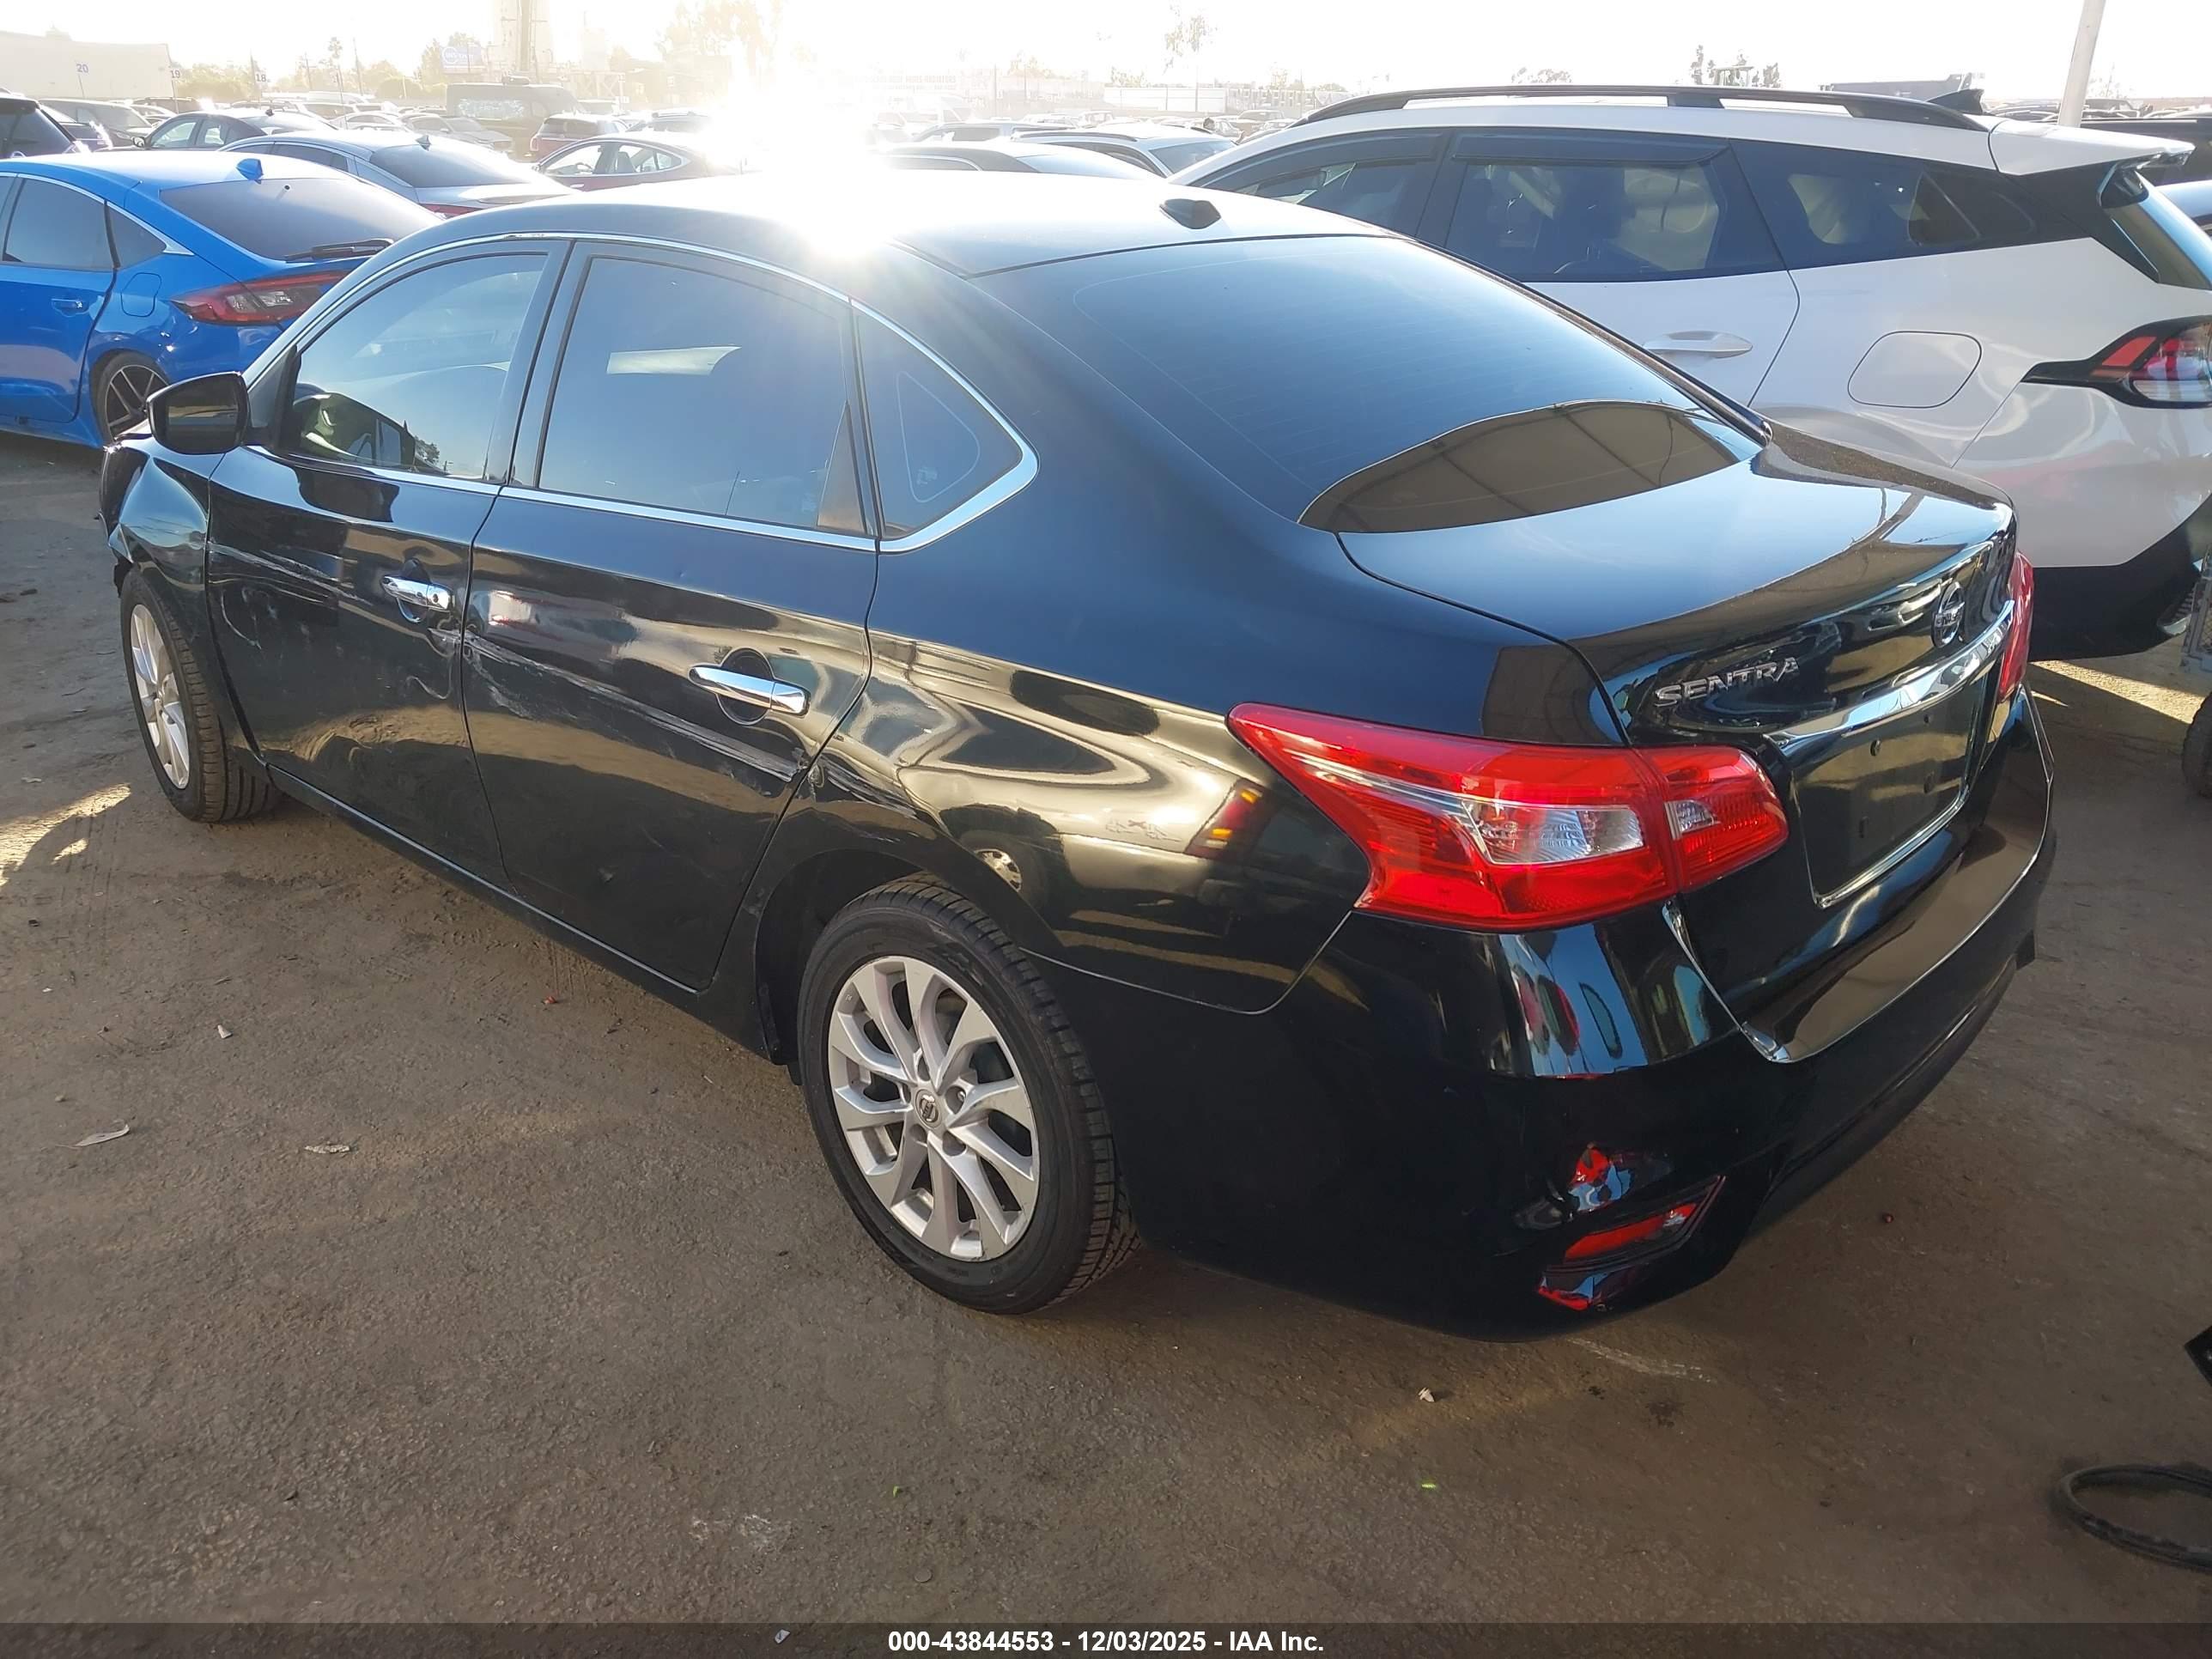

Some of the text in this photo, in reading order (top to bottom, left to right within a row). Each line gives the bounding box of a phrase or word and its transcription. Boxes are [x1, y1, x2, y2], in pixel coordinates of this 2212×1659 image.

[76, 64, 89, 74] 20
[170, 70, 180, 79] 19
[256, 73, 267, 82] 18
[1654, 657, 1800, 708] SENTRA
